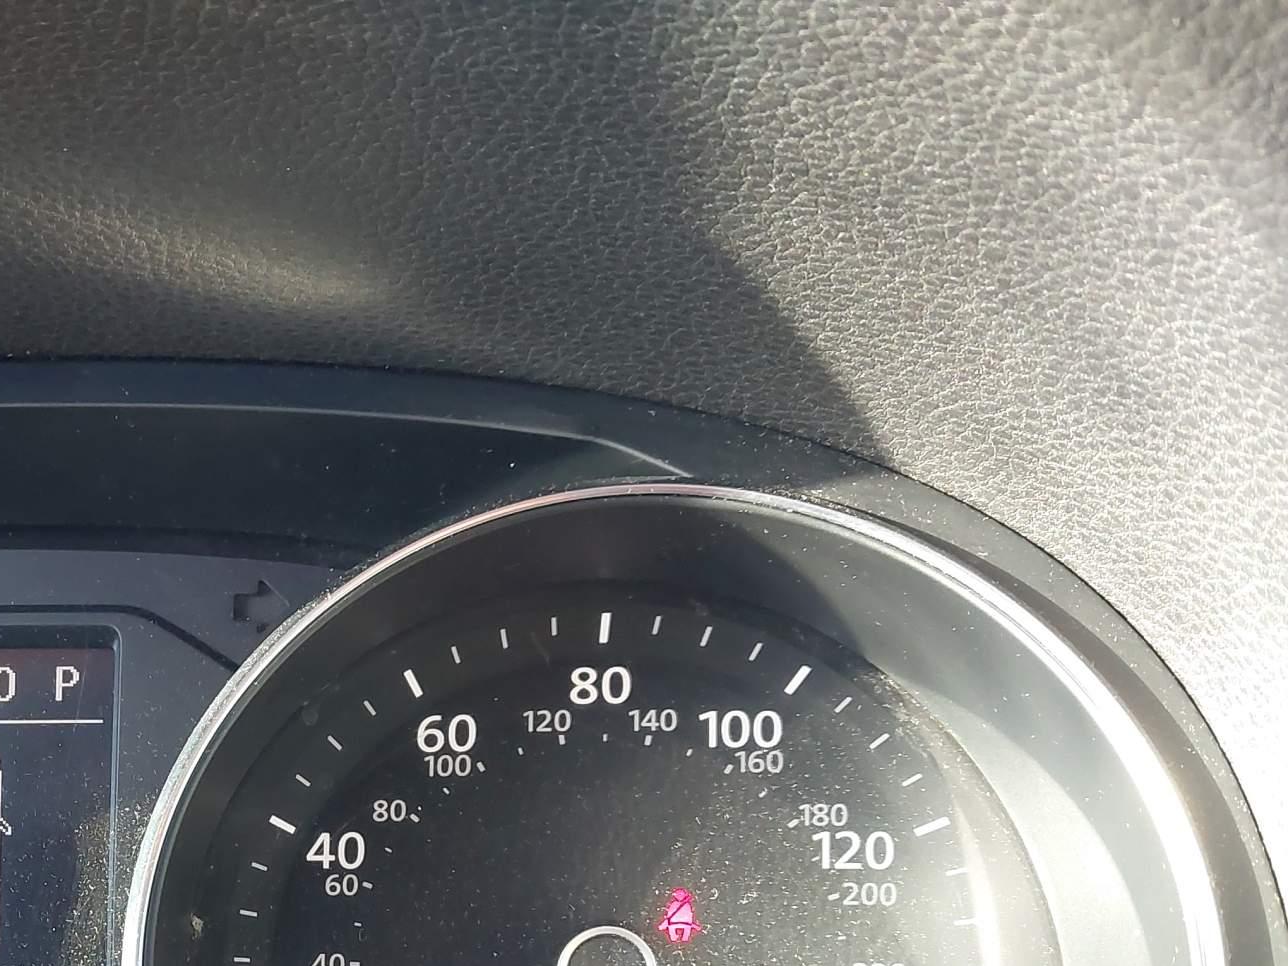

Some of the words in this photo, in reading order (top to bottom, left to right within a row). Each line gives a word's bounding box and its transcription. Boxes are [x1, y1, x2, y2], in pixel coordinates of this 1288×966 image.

[55, 665, 80, 701] P
[570, 666, 632, 705] 80
[523, 710, 572, 733] 120
[629, 709, 677, 733] 140
[699, 711, 783, 749] 100
[417, 714, 477, 754] 60
[425, 754, 472, 777] 100
[735, 751, 783, 774] 160
[373, 800, 407, 823] 80
[800, 803, 848, 827] 180
[306, 832, 366, 870] 40
[816, 832, 894, 870] 120
[325, 875, 359, 897] 60
[842, 883, 897, 907] 200
